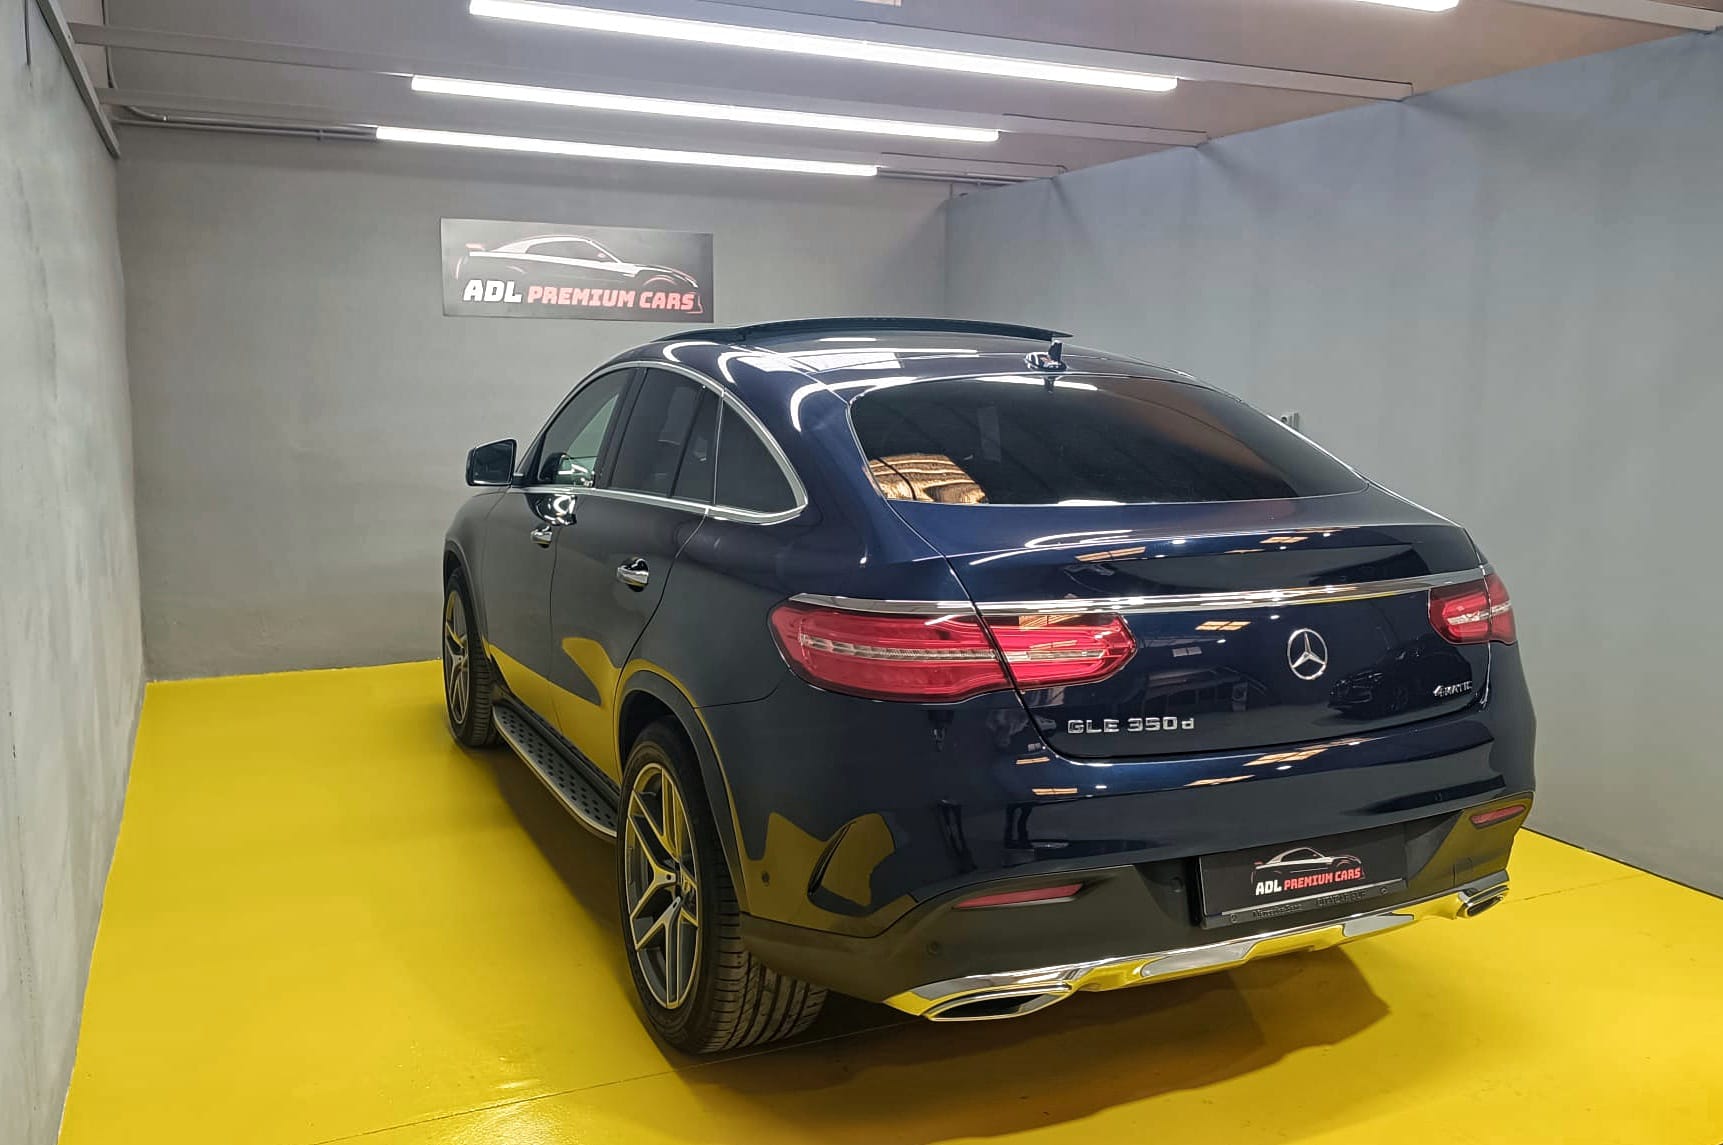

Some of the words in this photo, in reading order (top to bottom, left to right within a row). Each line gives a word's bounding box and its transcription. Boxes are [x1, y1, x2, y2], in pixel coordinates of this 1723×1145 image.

[463, 279, 523, 304] ADL
[527, 285, 635, 309] PREMIUM
[639, 291, 695, 311] CARS
[1067, 718, 1121, 734] GLE
[1255, 879, 1283, 896] ADL
[1283, 872, 1334, 891] PREMIUM
[1335, 866, 1362, 883] CARS
